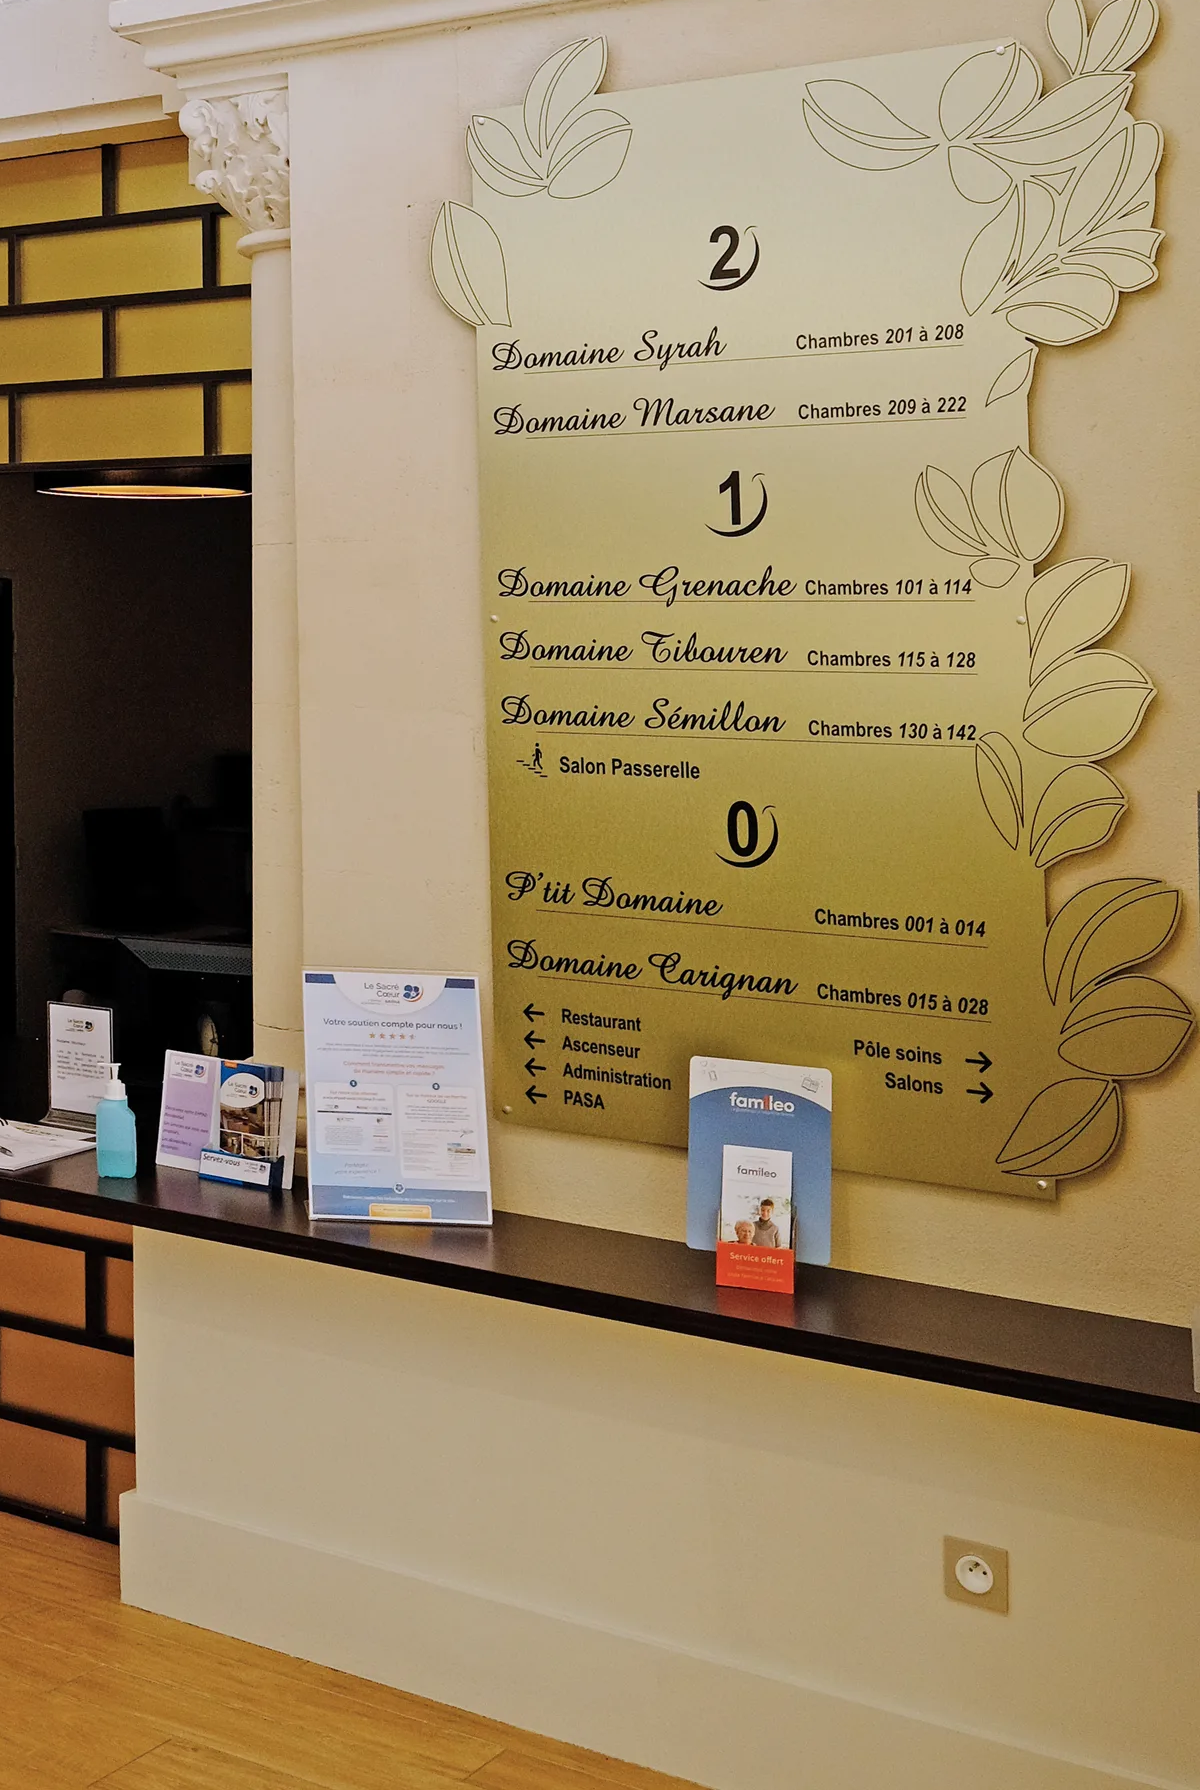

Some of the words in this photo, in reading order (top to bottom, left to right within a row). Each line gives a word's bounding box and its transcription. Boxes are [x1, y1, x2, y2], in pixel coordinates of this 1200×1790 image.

[709, 225, 741, 281] 2
[491, 339, 625, 371] Domaine
[633, 325, 728, 372] Syrah
[795, 331, 879, 351] Chambres
[885, 324, 913, 345] 201
[919, 325, 929, 342] à
[934, 323, 964, 341] 208
[493, 403, 627, 435] Domaine
[632, 397, 776, 427] Marsane
[798, 401, 882, 420] Chambres
[887, 398, 917, 416] 209
[921, 397, 931, 414] à
[936, 395, 967, 413] 222
[718, 470, 742, 526] 1
[497, 566, 632, 598] Domaine
[638, 564, 798, 608] Grenache
[805, 579, 889, 596] Chambres
[895, 579, 923, 595] 101
[928, 579, 939, 595] à
[943, 578, 972, 595] 114
[499, 629, 634, 662] Domaine
[640, 630, 789, 664] Tibouren
[807, 649, 892, 667] Chambres
[898, 651, 926, 668] 115
[930, 651, 940, 668] à
[946, 651, 976, 669] 128
[500, 694, 636, 728] Domaine
[644, 697, 787, 733] Sémillon
[808, 719, 893, 739] Chambres
[899, 722, 928, 740] 130
[932, 723, 943, 740] à
[946, 723, 977, 741] 142
[559, 755, 606, 775] Salon
[611, 757, 701, 780] Passerelle
[726, 800, 759, 858] 0
[581, 876, 724, 918] Domaine
[814, 908, 900, 931] Chambres
[904, 915, 934, 934] 001
[939, 917, 950, 935] à
[954, 919, 986, 938] 014
[506, 938, 644, 980] Domaine
[647, 951, 799, 1001] Carignan
[816, 983, 902, 1007] Chambres
[907, 991, 938, 1011] 015
[942, 995, 953, 1013] à
[957, 996, 989, 1016] 028
[323, 1018, 347, 1026] Votre
[347, 1019, 380, 1028] soutien
[380, 1021, 414, 1030] compte
[415, 1023, 435, 1031] pour
[437, 1023, 458, 1031] nous
[561, 1008, 642, 1033] Restaurant
[561, 1035, 641, 1059] Ascenseur
[853, 1039, 891, 1060] Pôle
[895, 1047, 943, 1065] soins
[562, 1062, 672, 1091] Administration
[884, 1071, 944, 1095] Salons
[563, 1089, 606, 1110] PASA
[729, 1091, 795, 1113] famileo
[203, 1153, 241, 1167] Servez-vous
[736, 1164, 778, 1180] famileo
[729, 1251, 760, 1263] Service
[760, 1255, 785, 1266] offert
